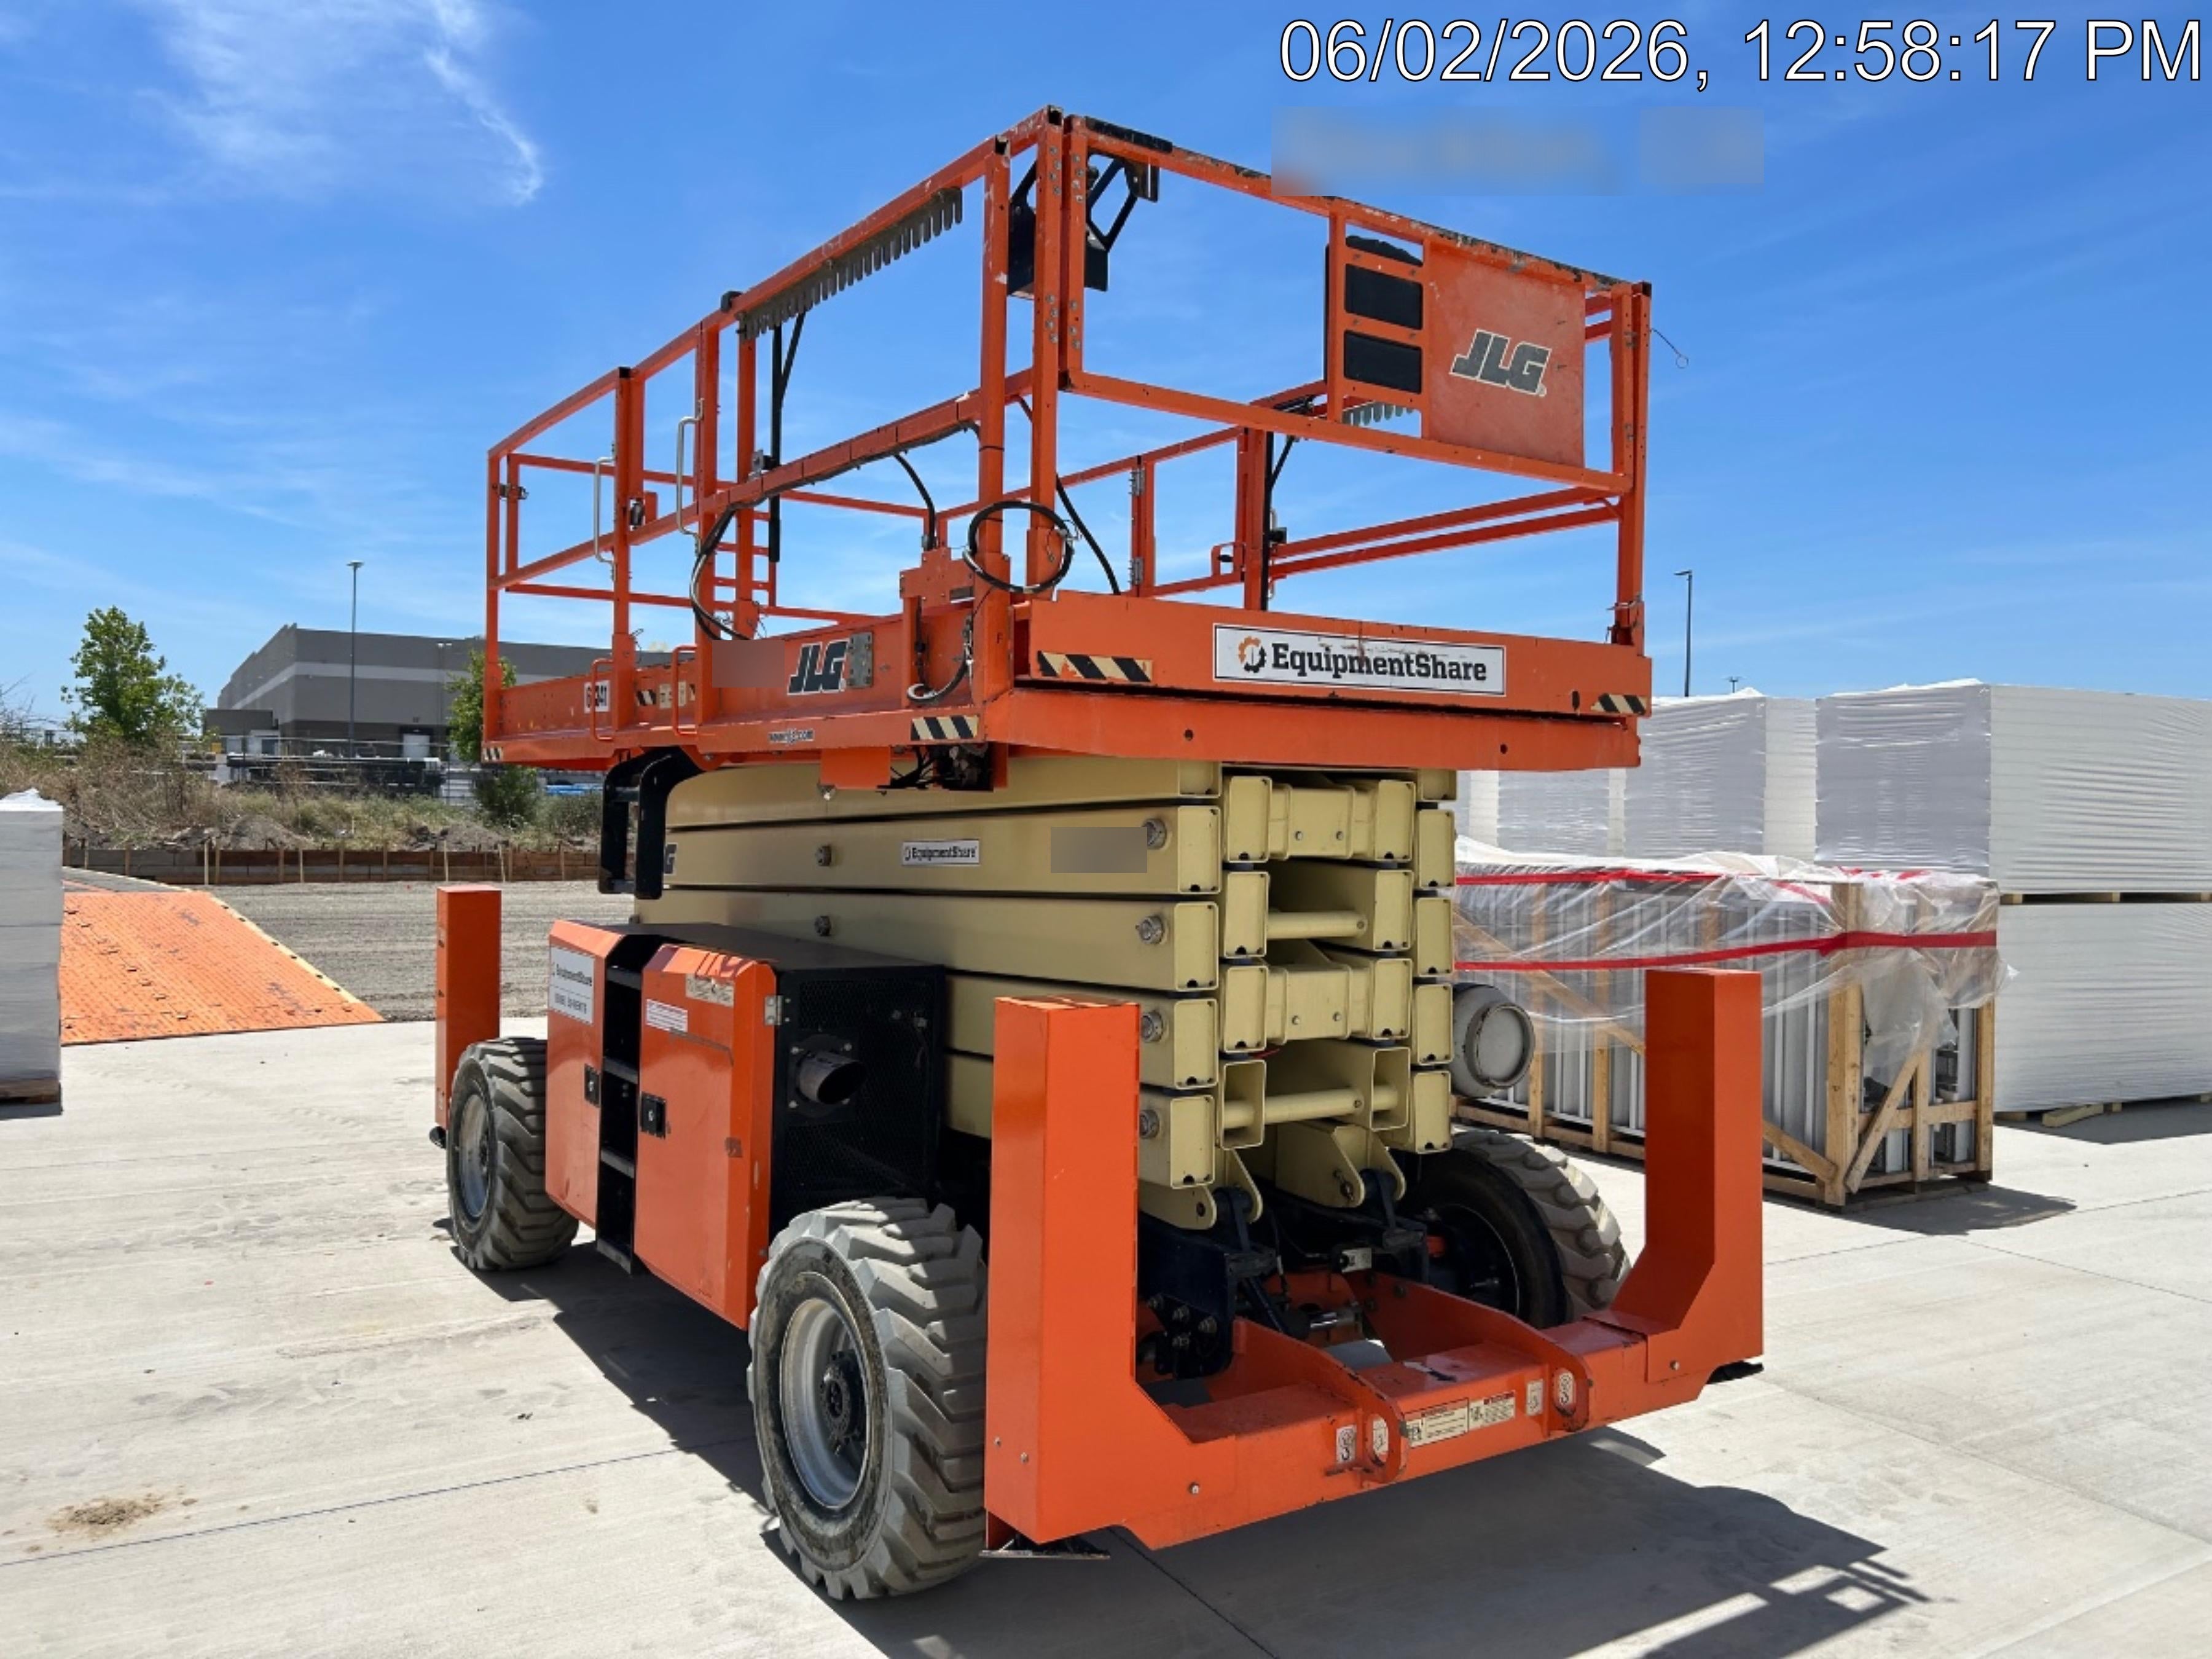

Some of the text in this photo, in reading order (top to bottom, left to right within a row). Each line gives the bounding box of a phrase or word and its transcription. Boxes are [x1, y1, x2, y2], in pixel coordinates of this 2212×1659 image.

[1449, 328, 1552, 395] JLG
[786, 638, 850, 696] JLG
[1271, 643, 1487, 681] EquipmentShare
